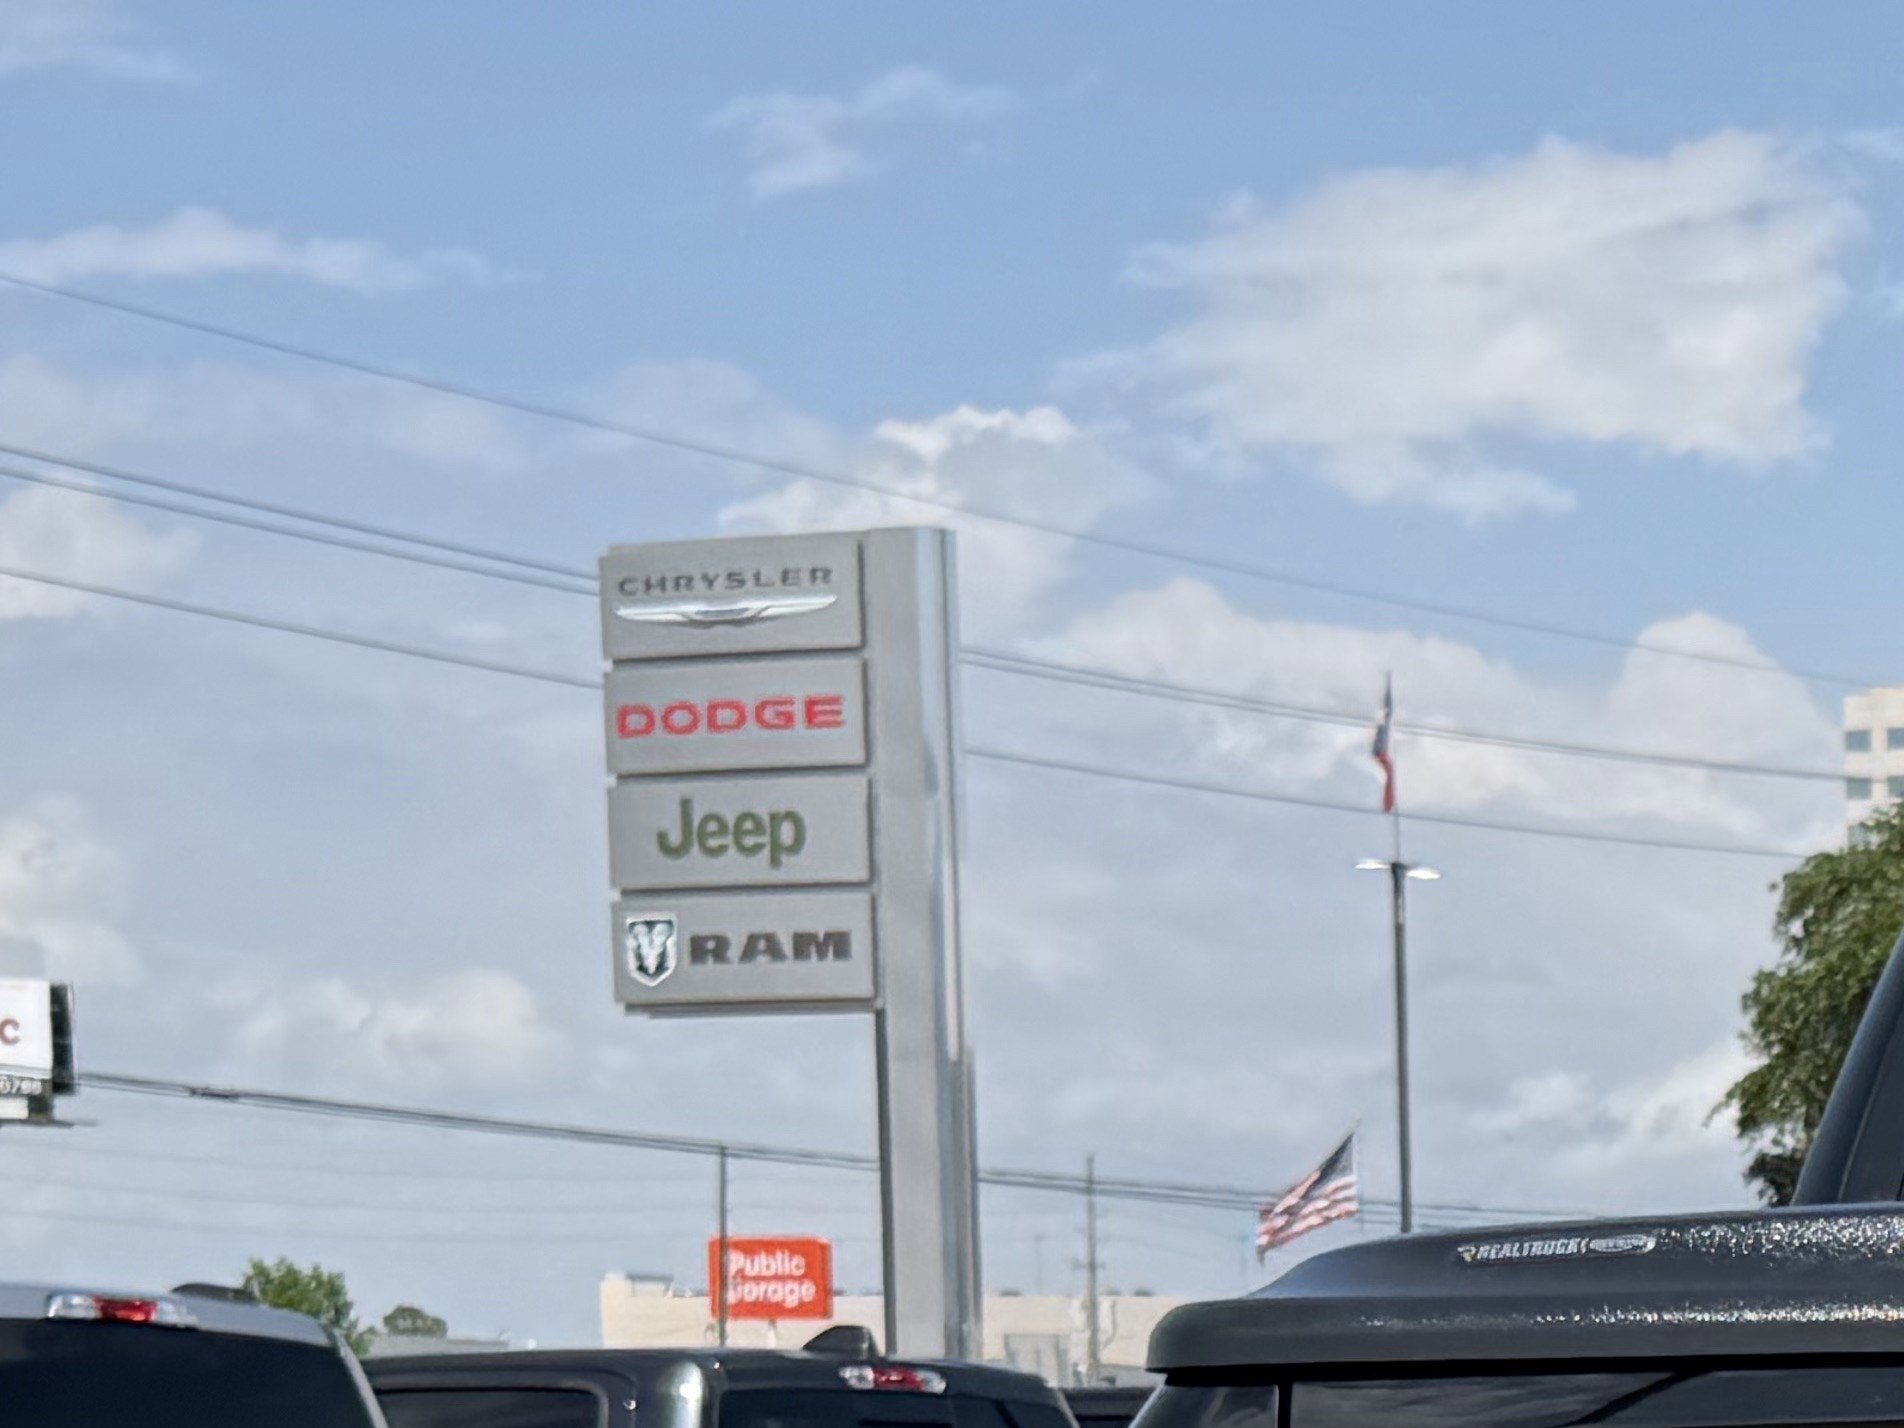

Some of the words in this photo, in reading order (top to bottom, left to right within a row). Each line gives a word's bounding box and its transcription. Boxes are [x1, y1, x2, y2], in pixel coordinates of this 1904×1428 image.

[617, 567, 833, 597] CHRYSLER
[615, 694, 845, 738] DODGE
[656, 797, 806, 869] Jeep
[689, 931, 852, 965] RAM
[728, 1248, 805, 1277] Public
